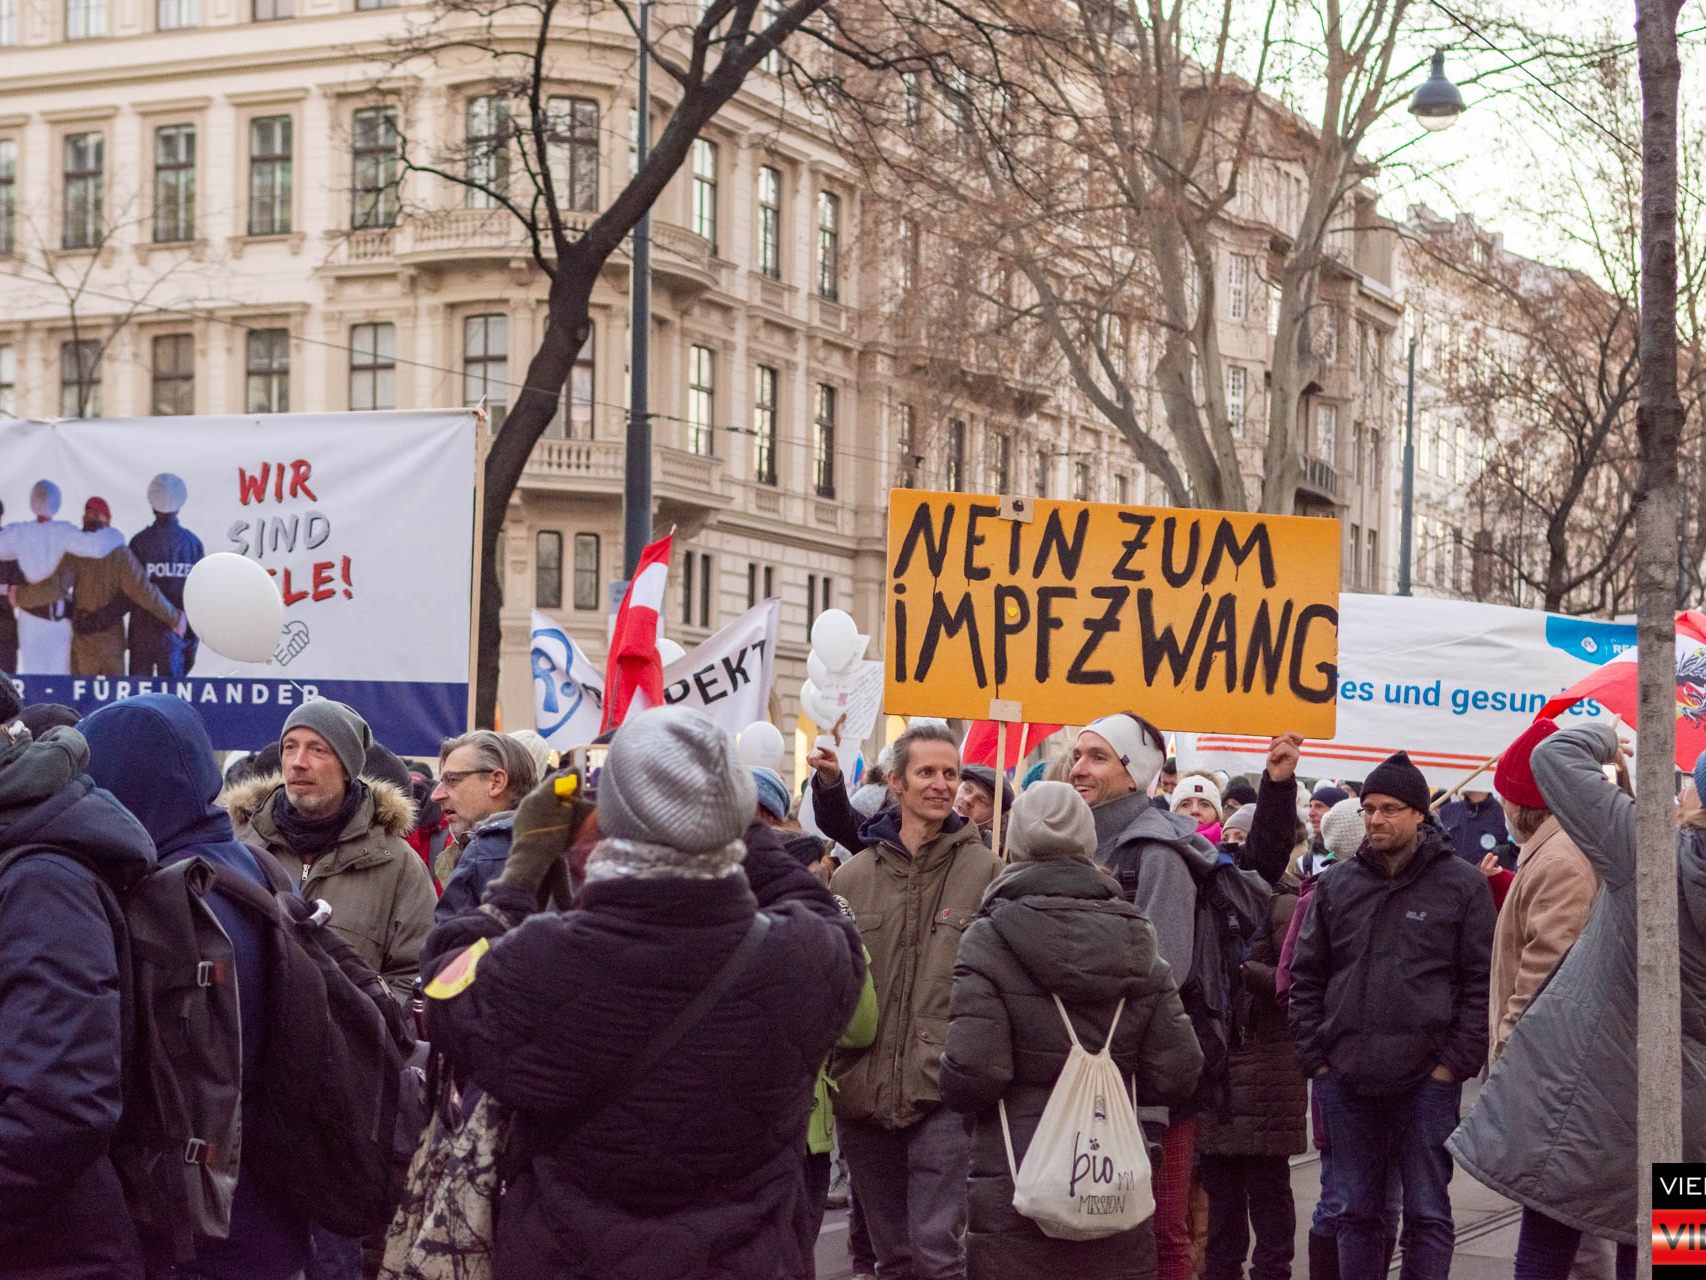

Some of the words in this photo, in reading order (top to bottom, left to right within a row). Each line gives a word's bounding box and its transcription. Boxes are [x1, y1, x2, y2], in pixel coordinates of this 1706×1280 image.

[239, 459, 317, 505] WIR
[227, 511, 330, 558] SIND
[1111, 511, 1277, 589] ZUM
[1336, 671, 1375, 701] es
[1384, 680, 1441, 707] und
[1451, 687, 1601, 717] gesunes
[1070, 1131, 1114, 1198] bio
[1079, 1194, 1127, 1216] MISSION
